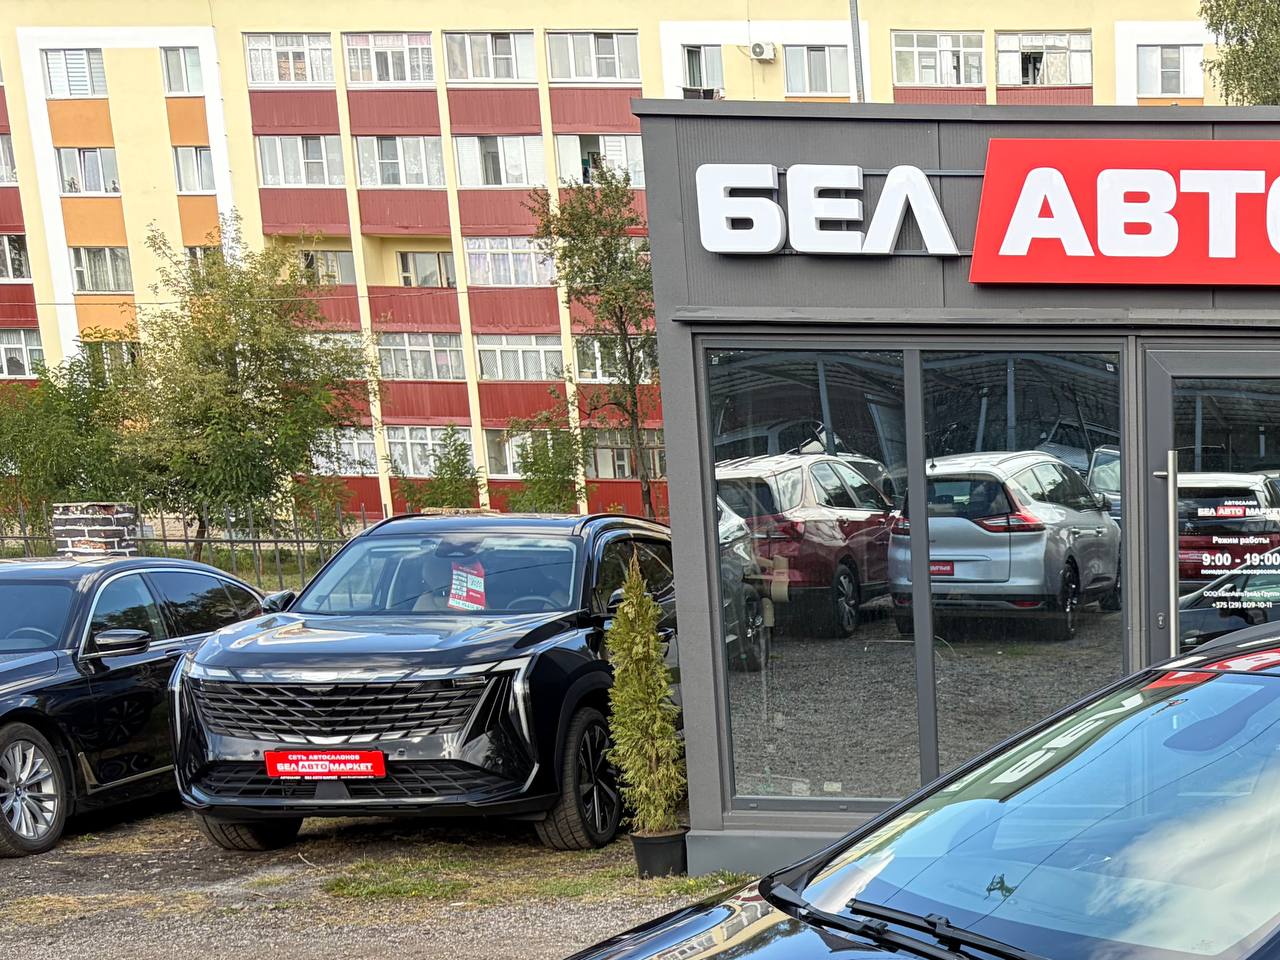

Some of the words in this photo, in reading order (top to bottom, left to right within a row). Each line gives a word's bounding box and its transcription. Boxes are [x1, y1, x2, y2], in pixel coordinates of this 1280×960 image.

[695, 163, 960, 256] БЕЛ
[1197, 507, 1216, 516] БЕЛ
[1218, 507, 1243, 515] АВТО
[1212, 536, 1239, 544] Режим
[1240, 535, 1270, 545] работы
[1202, 553, 1232, 566] 9:00
[1243, 553, 1280, 566] 19:00
[1211, 601, 1228, 609] +375
[1228, 601, 1242, 609] (29)
[1242, 601, 1273, 609] 809-10-11
[277, 763, 298, 772] БЕЛ
[300, 763, 328, 771] АВТО
[329, 763, 373, 771] МАРКЕТ
